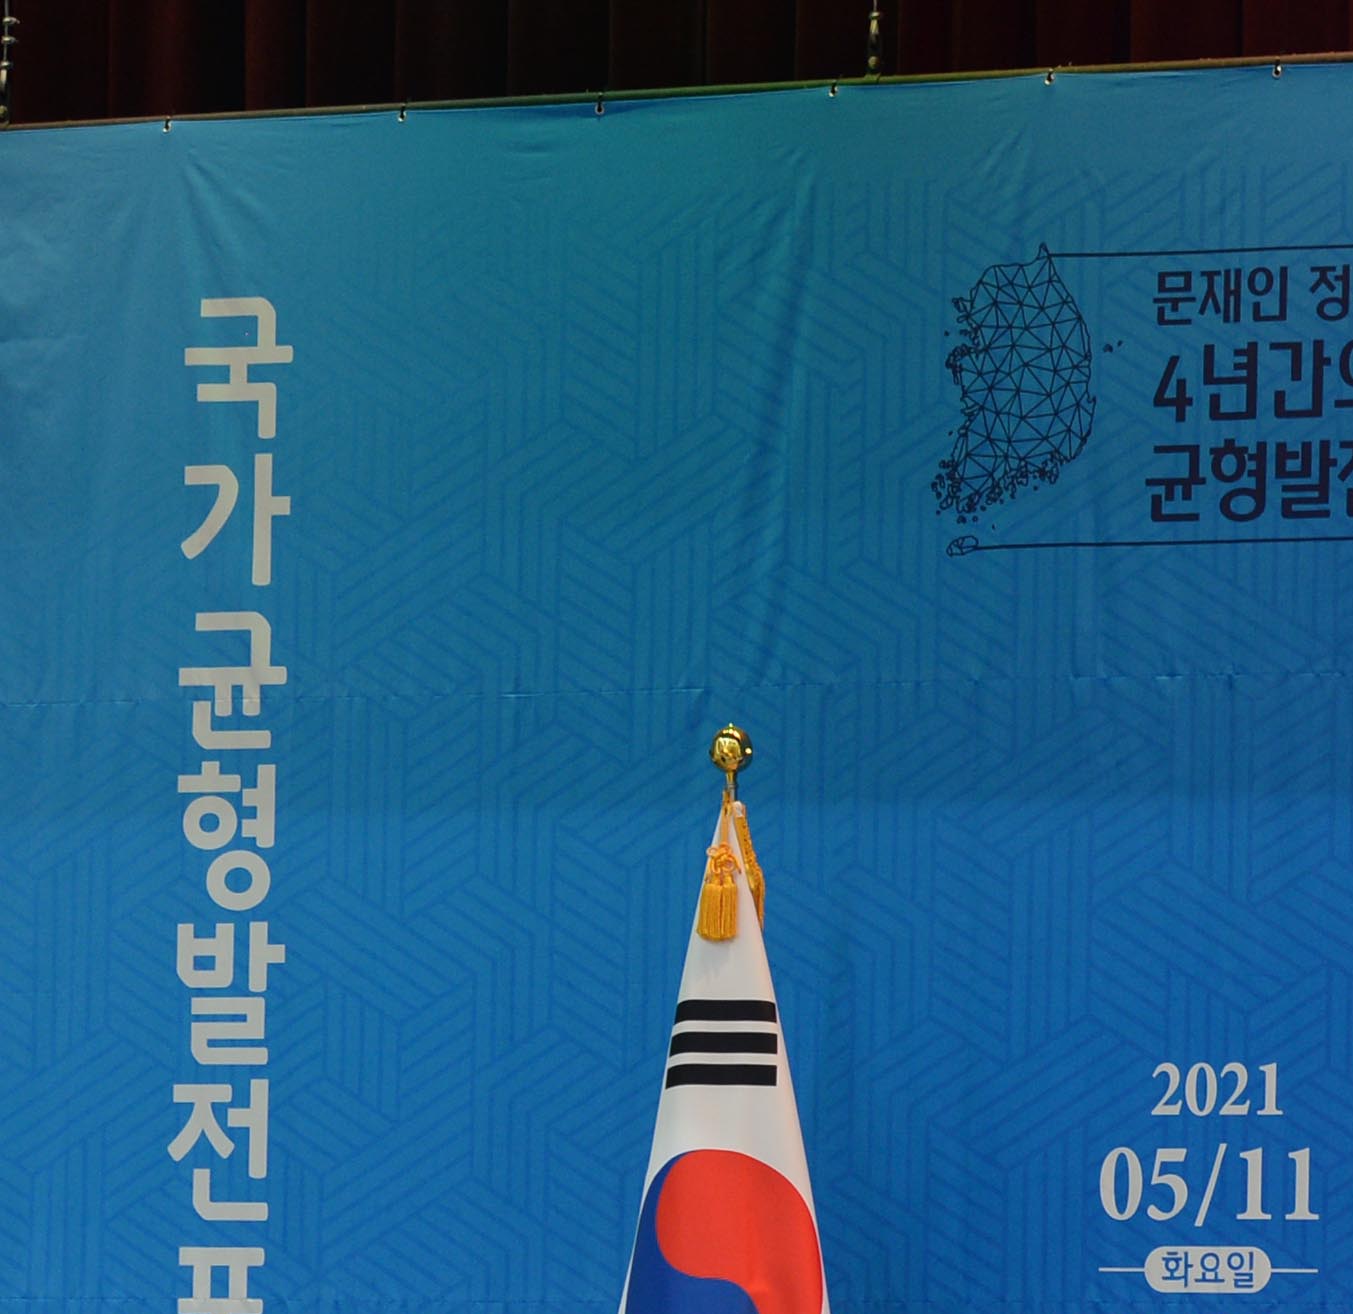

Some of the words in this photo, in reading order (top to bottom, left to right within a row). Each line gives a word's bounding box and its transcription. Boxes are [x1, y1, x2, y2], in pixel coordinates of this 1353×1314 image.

[1152, 266, 1289, 325] 문재인
[1151, 1062, 1284, 1116] 2021
[1099, 1143, 1320, 1227] 05/11
[1160, 1251, 1255, 1288] 화요일
